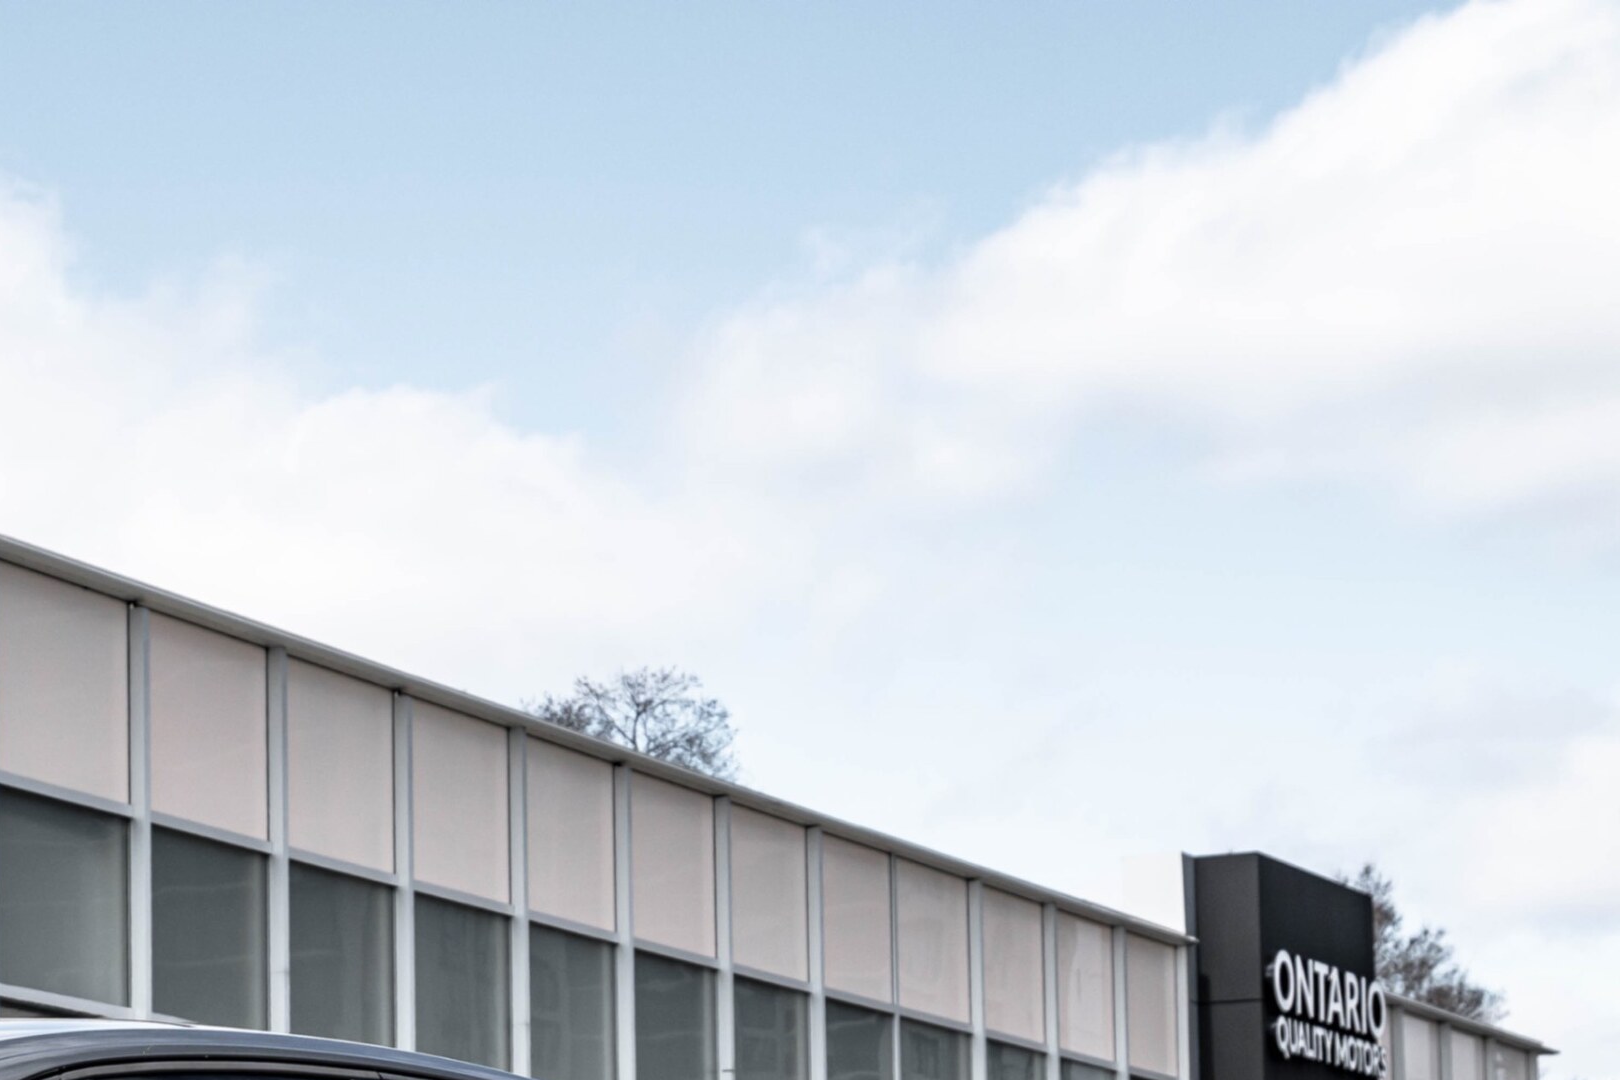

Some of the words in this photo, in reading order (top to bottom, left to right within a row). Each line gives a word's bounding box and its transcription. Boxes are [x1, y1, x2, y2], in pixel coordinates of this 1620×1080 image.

[1273, 948, 1387, 1040] ONTARIO
[1276, 1014, 1334, 1065] QUALITY
[1334, 1031, 1388, 1078] MOTORS
